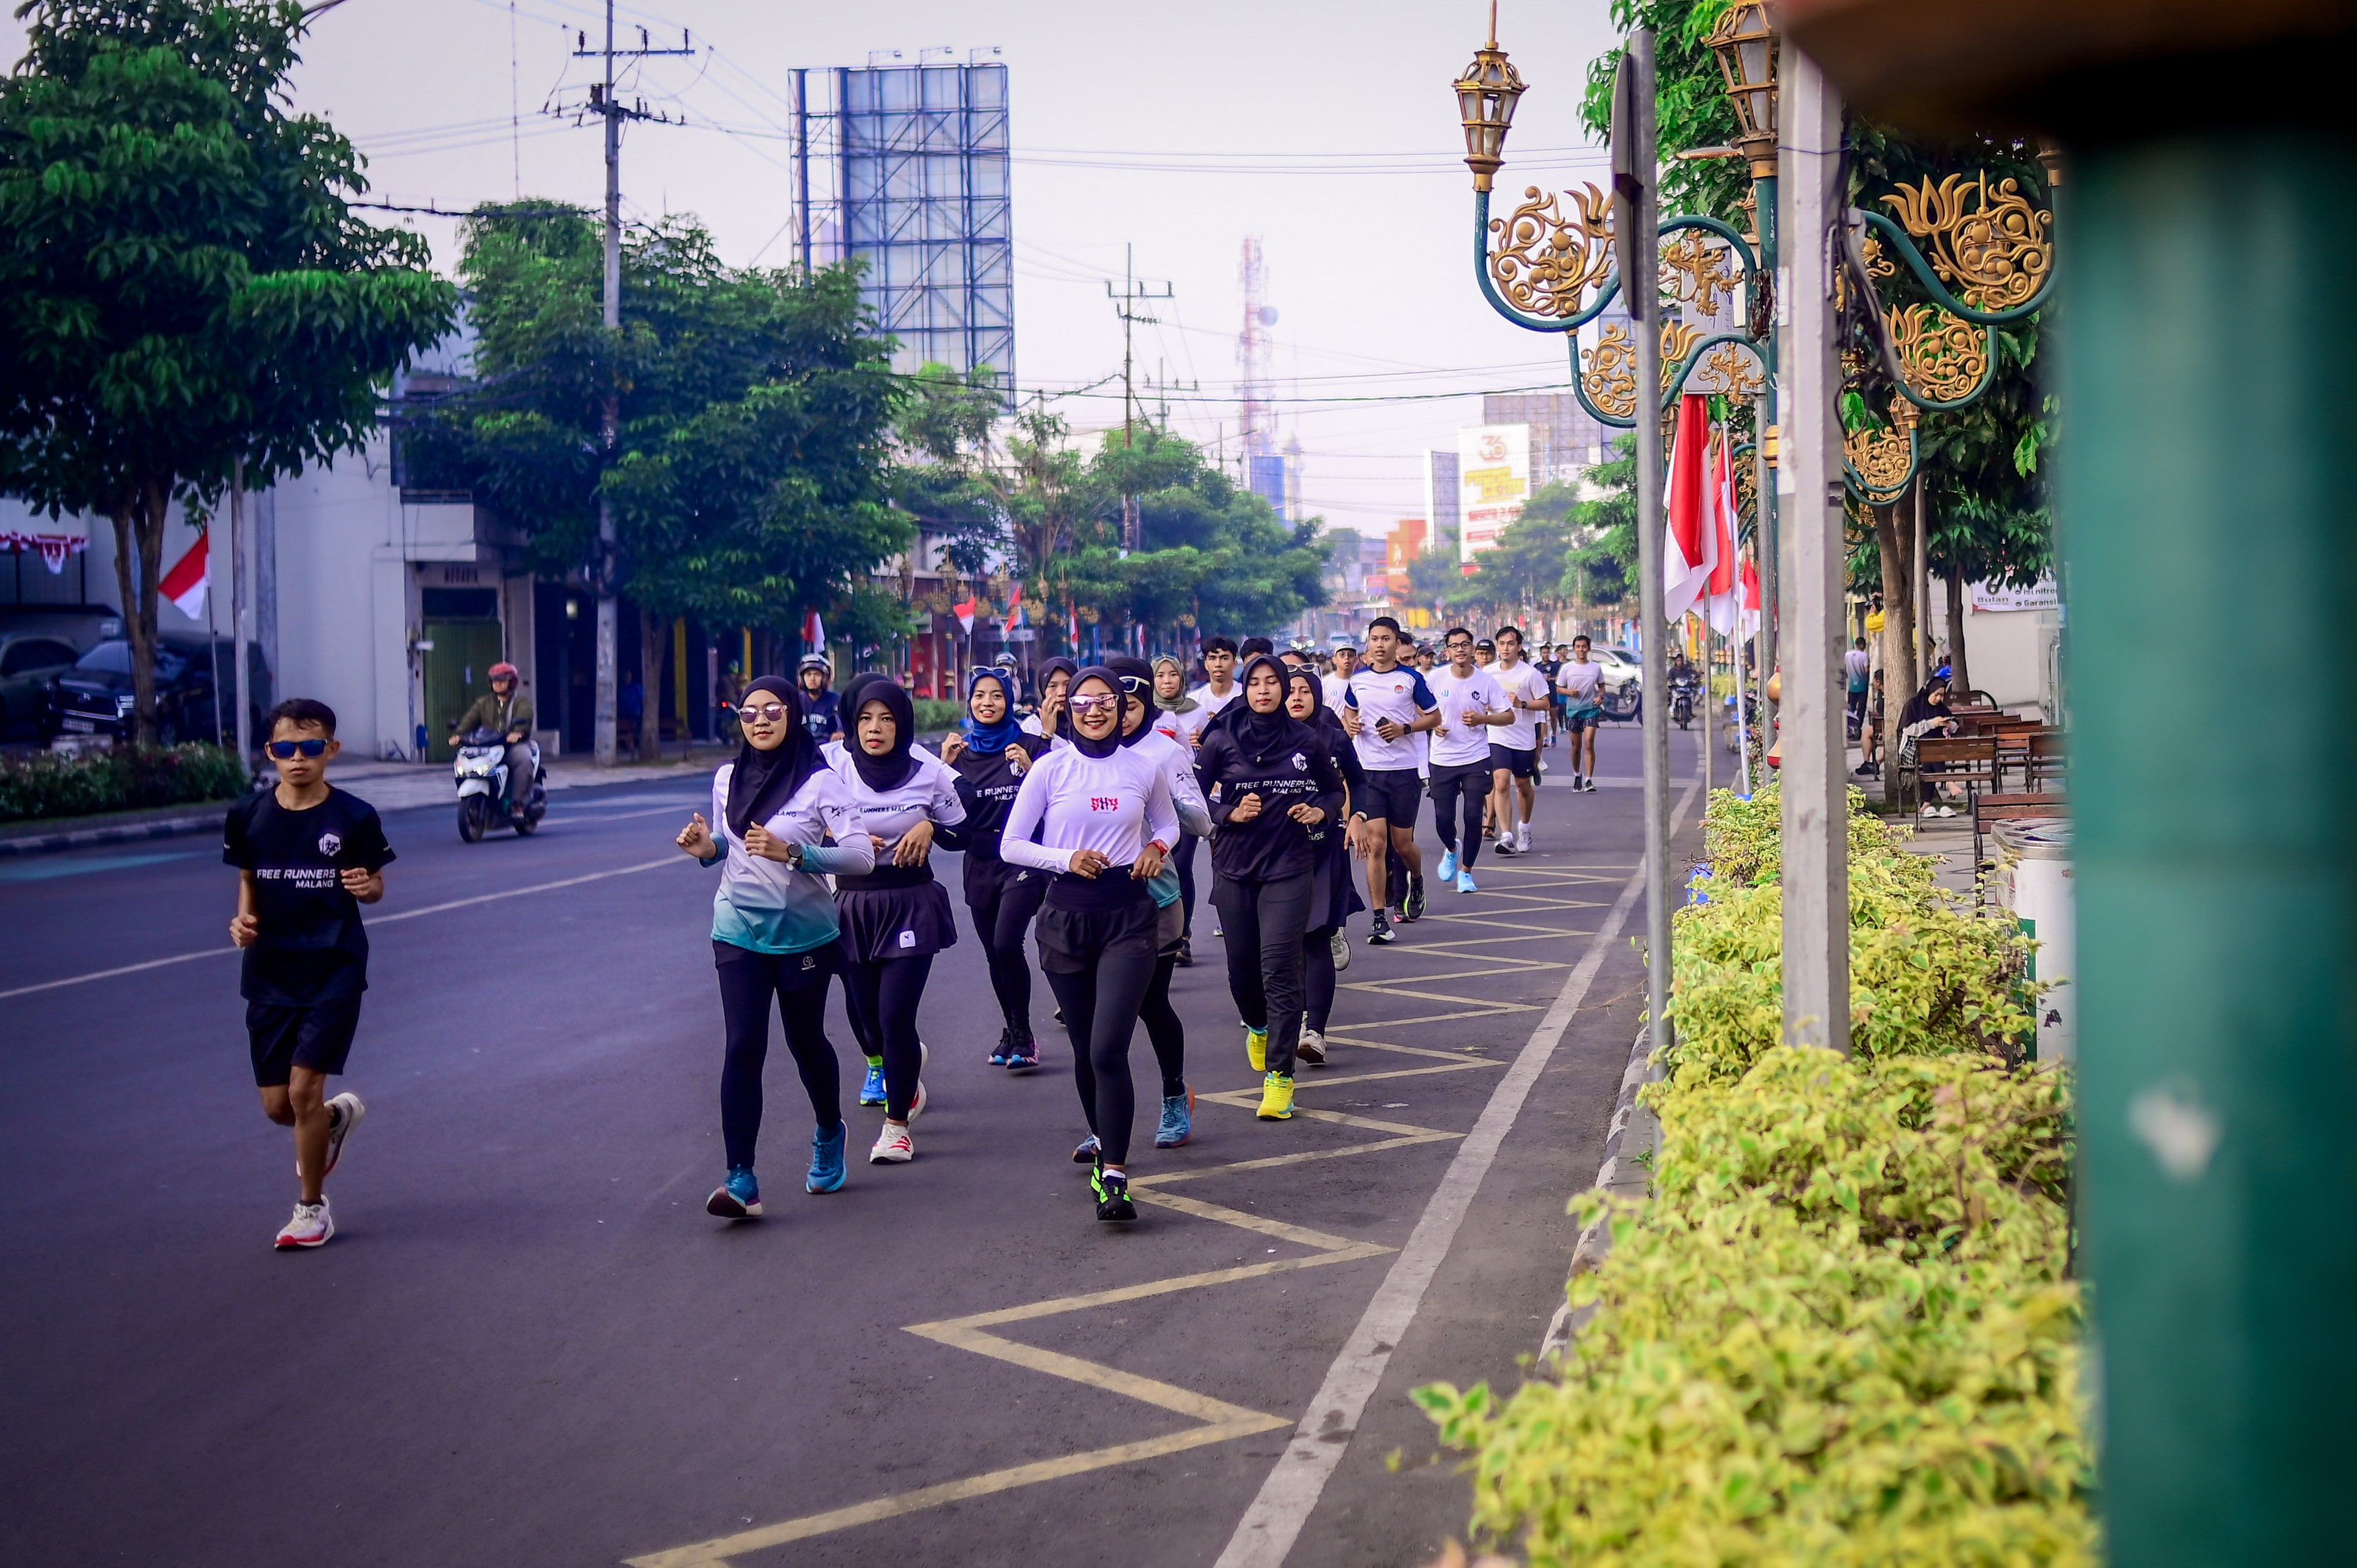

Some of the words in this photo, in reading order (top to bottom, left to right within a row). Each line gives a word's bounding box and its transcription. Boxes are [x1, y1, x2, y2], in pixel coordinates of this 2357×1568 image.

[1235, 781, 1260, 790] FREE
[1262, 779, 1305, 788] RUNNERS
[984, 785, 1020, 797] RUNNER
[257, 868, 281, 879] FREE
[283, 868, 336, 879] RUNNERS
[295, 879, 334, 889] MALANG
